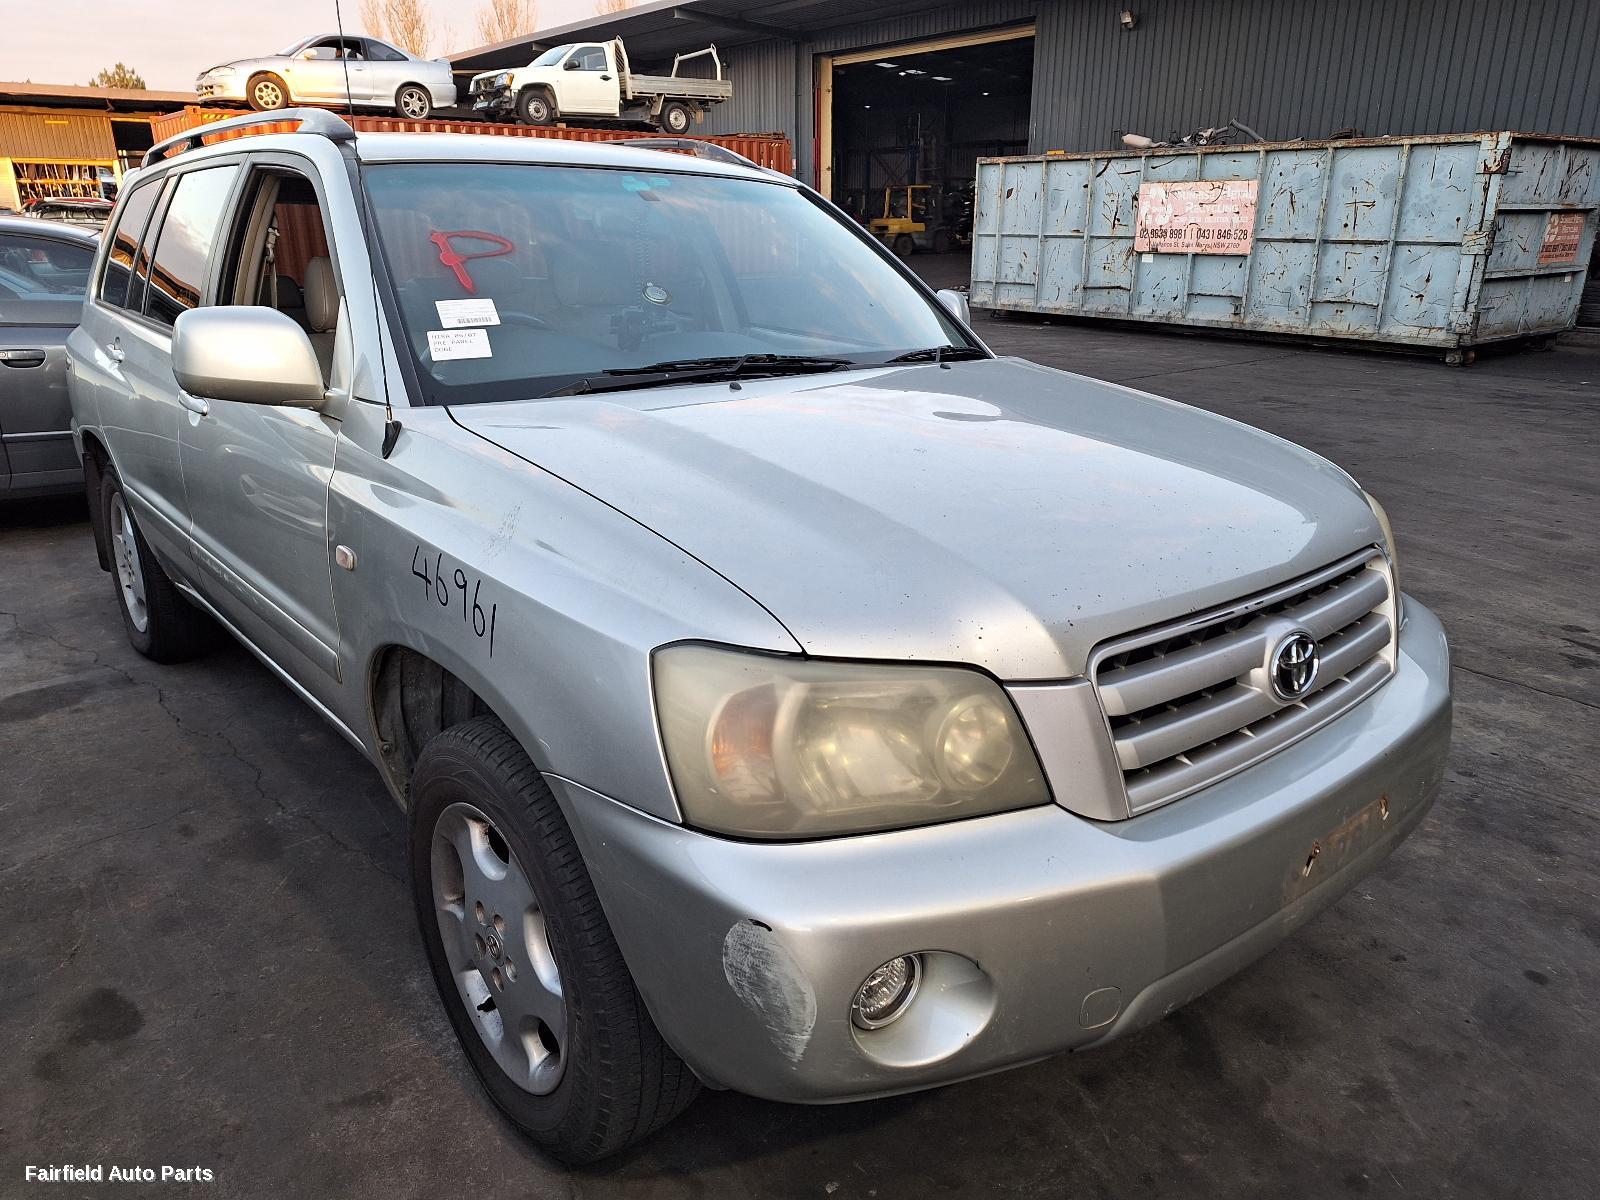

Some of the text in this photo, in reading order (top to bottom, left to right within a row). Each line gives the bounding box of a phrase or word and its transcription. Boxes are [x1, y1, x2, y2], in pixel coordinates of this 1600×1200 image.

[430, 230, 513, 296] P
[1169, 228, 1186, 240] 8981
[1196, 227, 1214, 240] 0431
[1216, 229, 1231, 240] 846
[1233, 229, 1248, 241] 528
[411, 545, 497, 660] 46961
